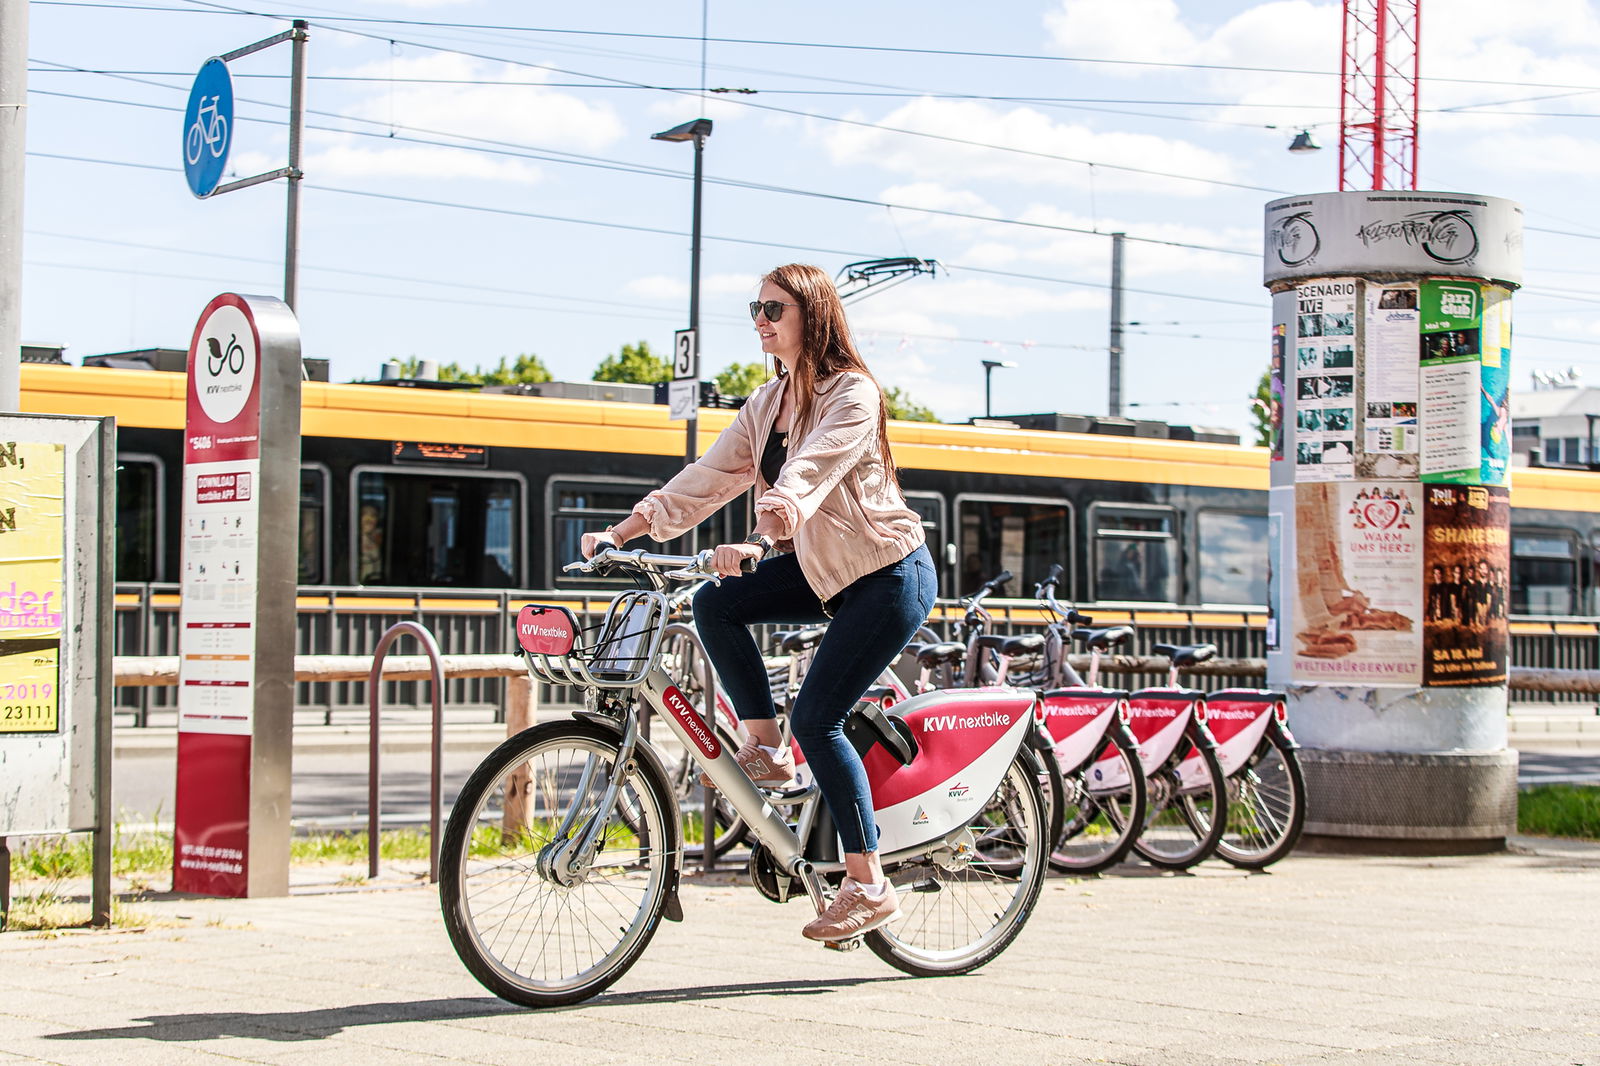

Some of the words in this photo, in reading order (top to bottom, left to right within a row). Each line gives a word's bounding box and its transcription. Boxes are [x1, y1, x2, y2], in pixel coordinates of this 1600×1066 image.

[1298, 283, 1355, 298] SCENARIO
[1440, 291, 1471, 305] jazz
[1298, 300, 1323, 314] LIVE
[1440, 303, 1471, 315] club
[680, 335, 690, 374] 3
[1364, 532, 1403, 541] WARM
[1350, 543, 1375, 552] UMS
[521, 623, 568, 639] KVV.nextbike
[4, 706, 51, 719] 23111
[668, 694, 715, 753] KVV.nextbike
[923, 711, 1010, 732] KVV.nextbike
